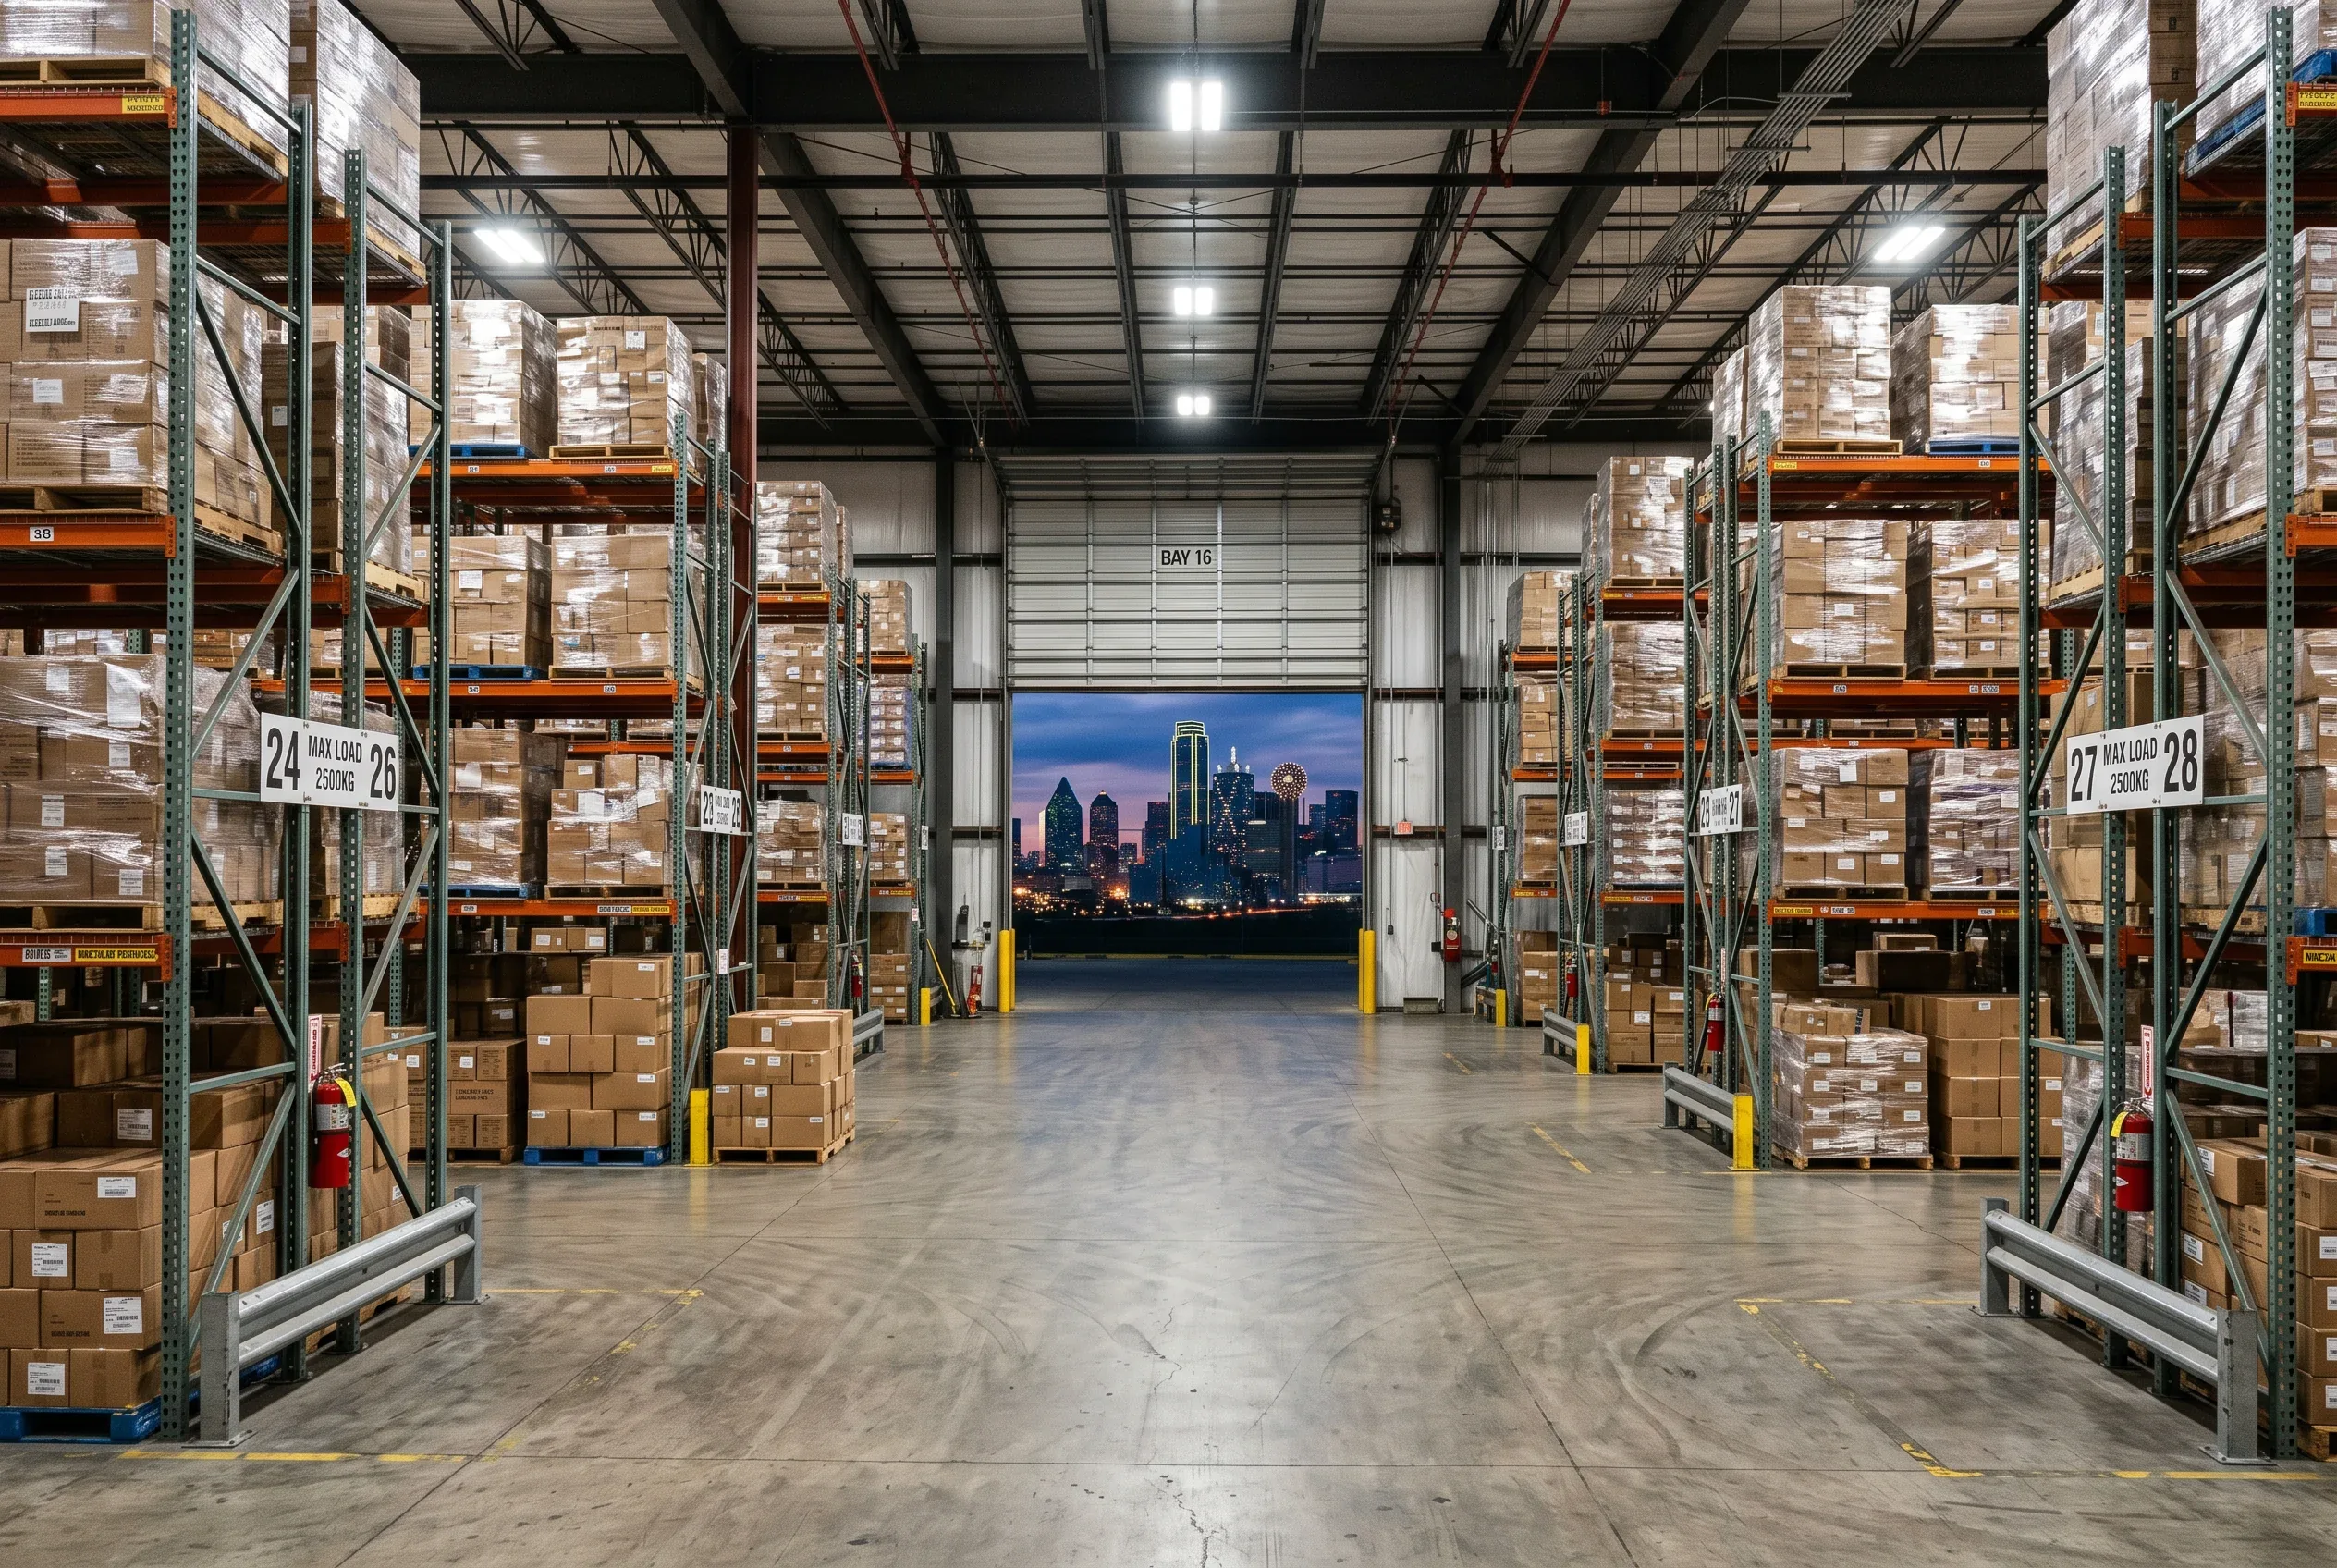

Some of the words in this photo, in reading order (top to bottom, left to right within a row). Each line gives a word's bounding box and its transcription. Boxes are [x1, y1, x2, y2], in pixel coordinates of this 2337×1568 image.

[34, 528, 51, 539] 38
[1161, 549, 1191, 565] BAY
[1195, 549, 1212, 565] 16
[266, 727, 300, 790] 24
[308, 735, 332, 760] MAX
[335, 739, 362, 764] LOAD
[2103, 741, 2126, 766] MAX
[2129, 737, 2158, 763] LOAD
[2163, 729, 2198, 793] 28
[315, 767, 355, 792] 2500KG
[370, 743, 397, 801] 26
[2071, 745, 2098, 802] 27
[2111, 768, 2149, 794] 2500KG
[1729, 791, 1740, 826] 27
